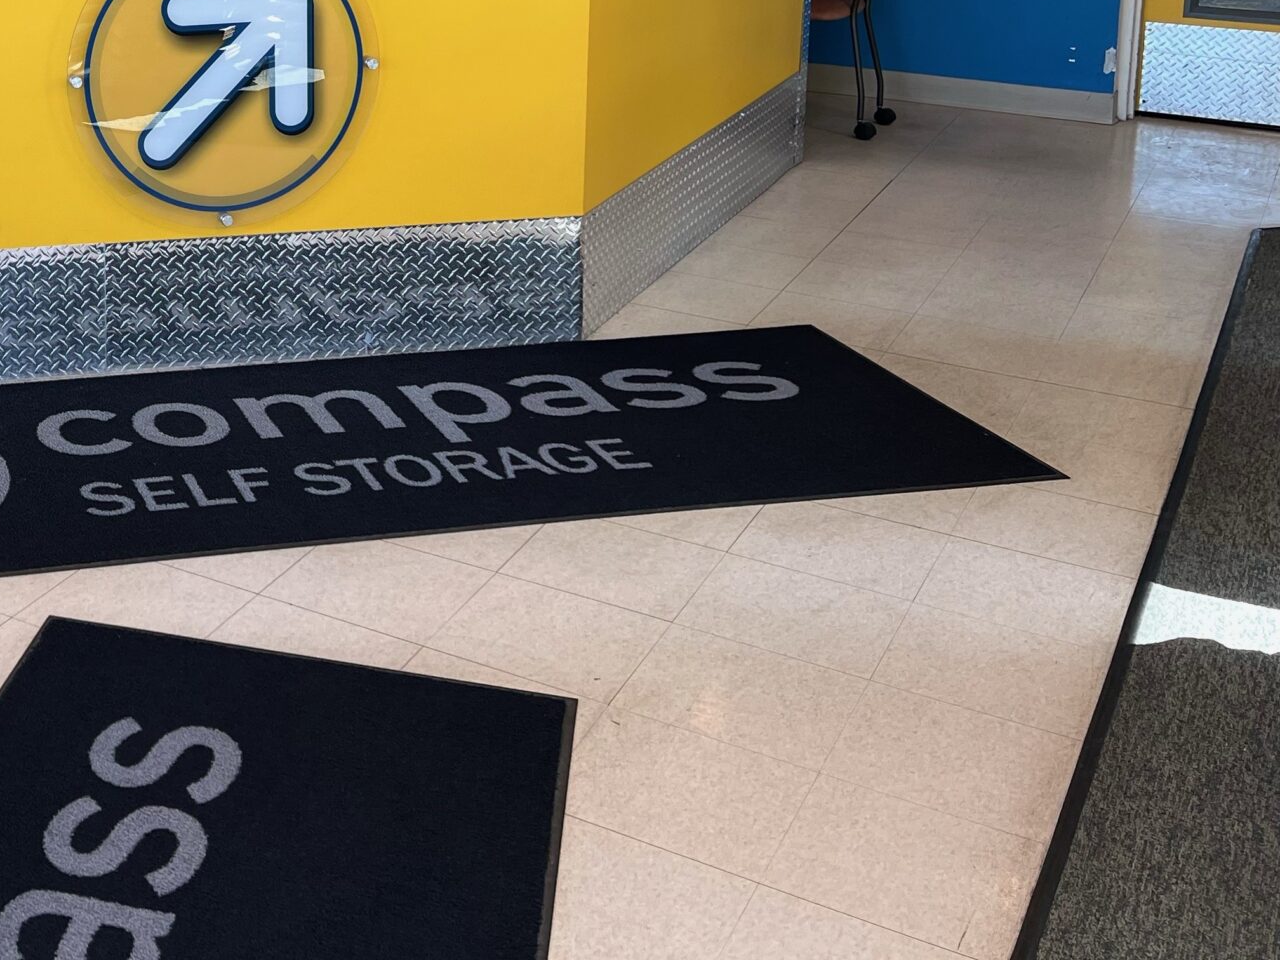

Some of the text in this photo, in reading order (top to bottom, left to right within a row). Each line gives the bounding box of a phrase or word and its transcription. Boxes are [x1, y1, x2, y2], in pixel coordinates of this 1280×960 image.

[36, 360, 800, 456] compass
[78, 437, 654, 517] SELF STORAGE
